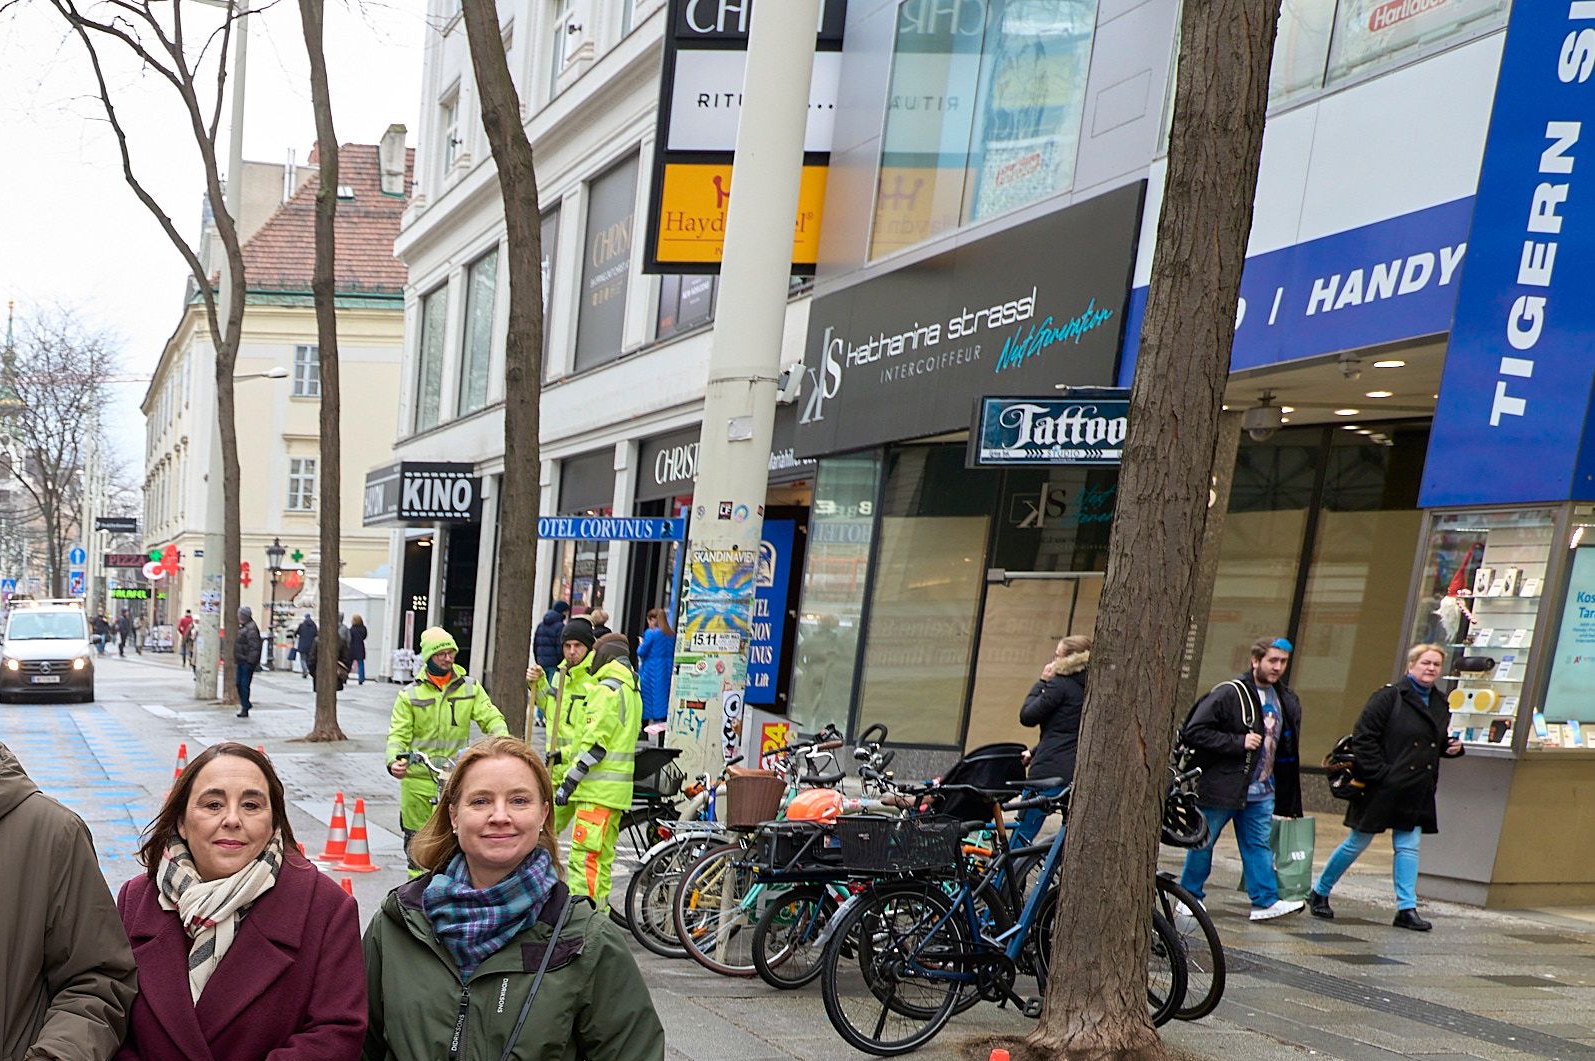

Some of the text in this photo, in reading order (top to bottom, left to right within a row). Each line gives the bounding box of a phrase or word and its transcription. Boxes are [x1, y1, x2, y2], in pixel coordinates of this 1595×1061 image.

[664, 211, 726, 239] Hayd
[1306, 242, 1468, 316] HANDY
[1489, 121, 1582, 427] TIGERN
[846, 286, 1038, 368] katharina strassl
[880, 344, 982, 384] INTERCOIFFEUR
[999, 403, 1128, 450] Tattoo
[402, 478, 473, 511] KINO
[538, 517, 653, 539] OTEL CORVINUS
[108, 556, 146, 566] PIZZA
[693, 550, 756, 563] SKANDINAVIEN
[755, 674, 769, 687] Lift
